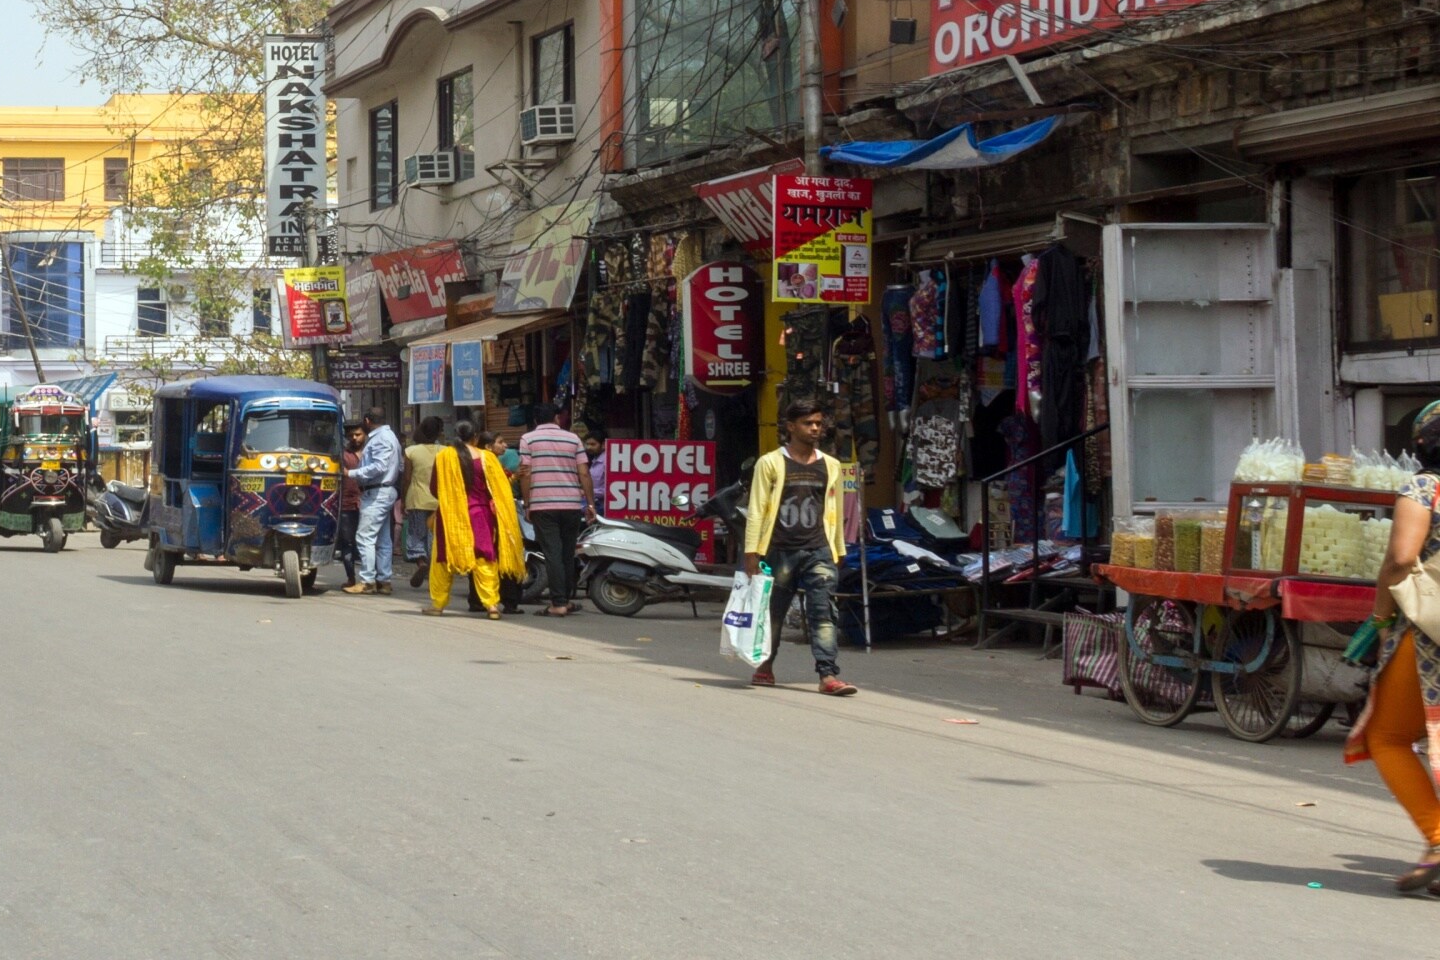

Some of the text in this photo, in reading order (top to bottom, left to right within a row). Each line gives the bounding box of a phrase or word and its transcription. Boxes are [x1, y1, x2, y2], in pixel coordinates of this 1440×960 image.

[271, 45, 319, 61] HOTEL
[848, 191, 861, 200] का
[704, 267, 749, 359] HOTEL
[707, 362, 750, 377] SHREE
[610, 443, 711, 475] HOTEL
[609, 481, 709, 512] SHREE
[654, 516, 675, 525] NON
